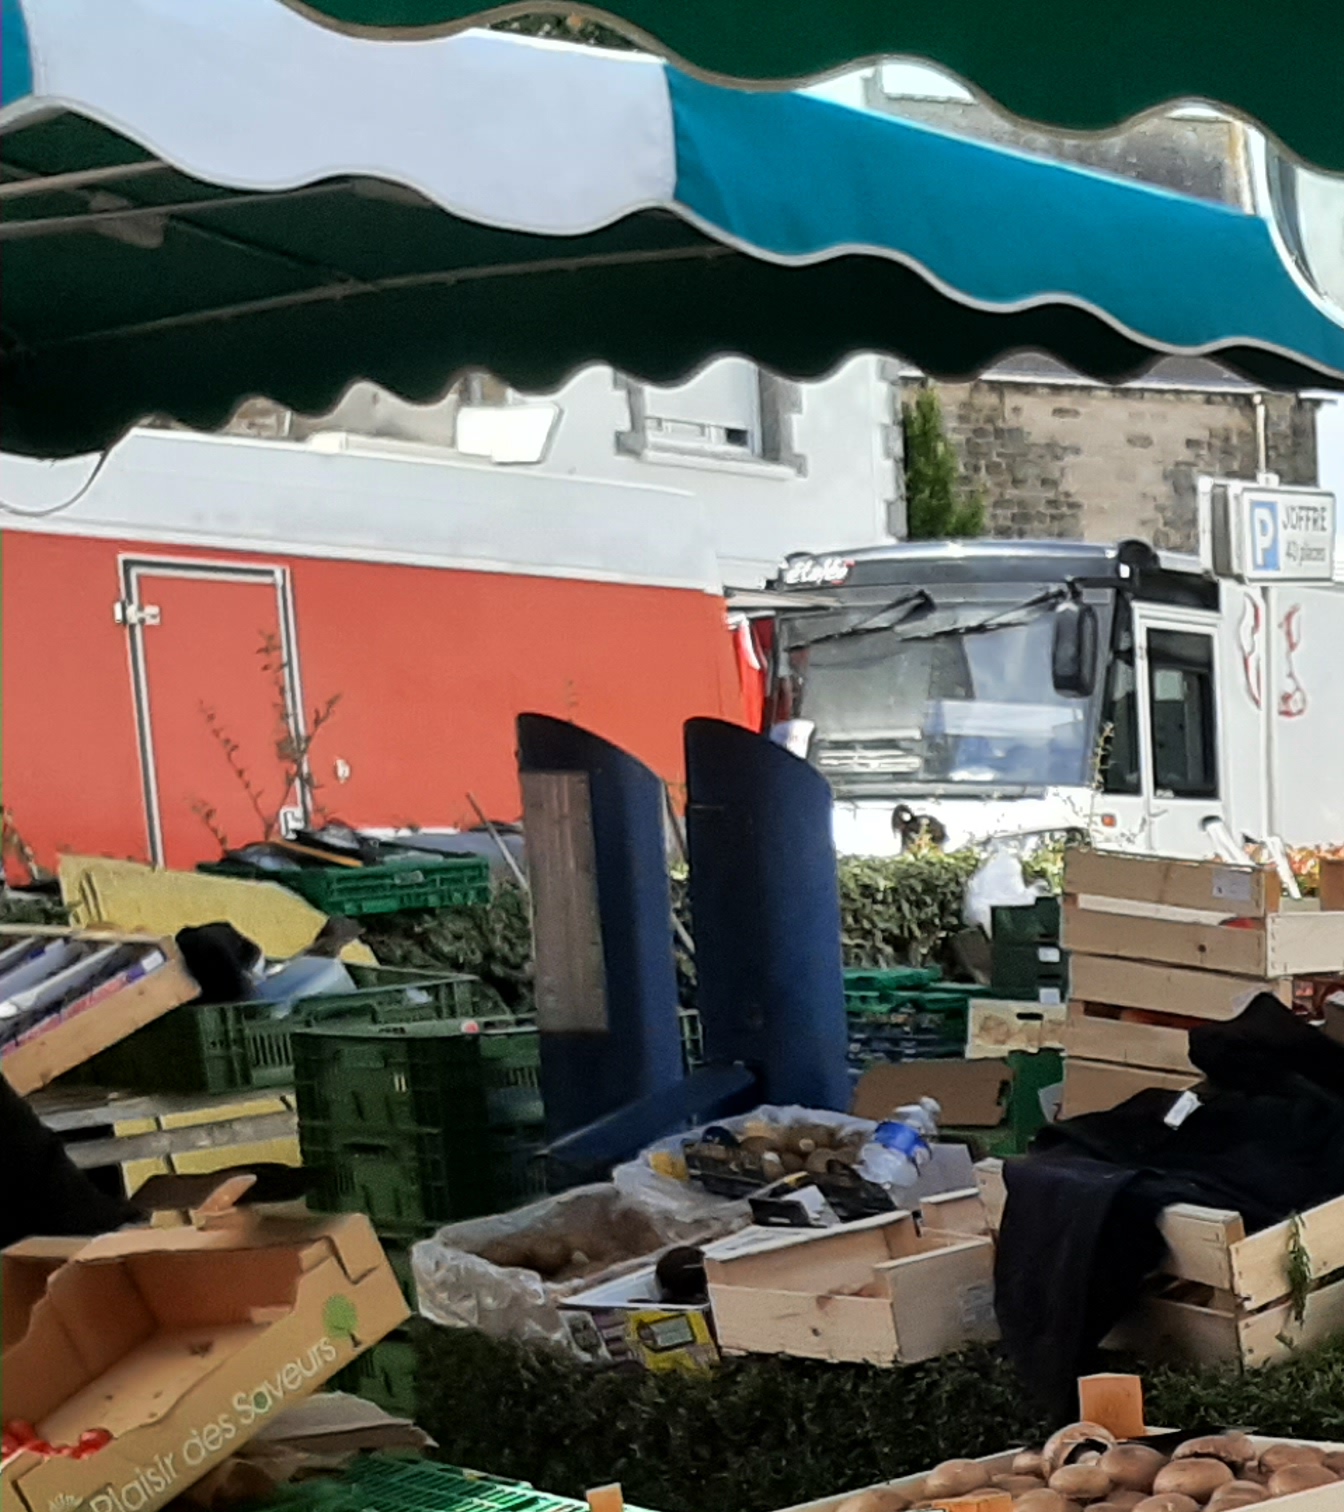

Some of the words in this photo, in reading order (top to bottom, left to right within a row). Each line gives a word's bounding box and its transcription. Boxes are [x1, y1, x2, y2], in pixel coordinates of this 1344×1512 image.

[1282, 505, 1327, 532] JOFFRE
[182, 1412, 237, 1467] des
[232, 1336, 338, 1425] Saveurs
